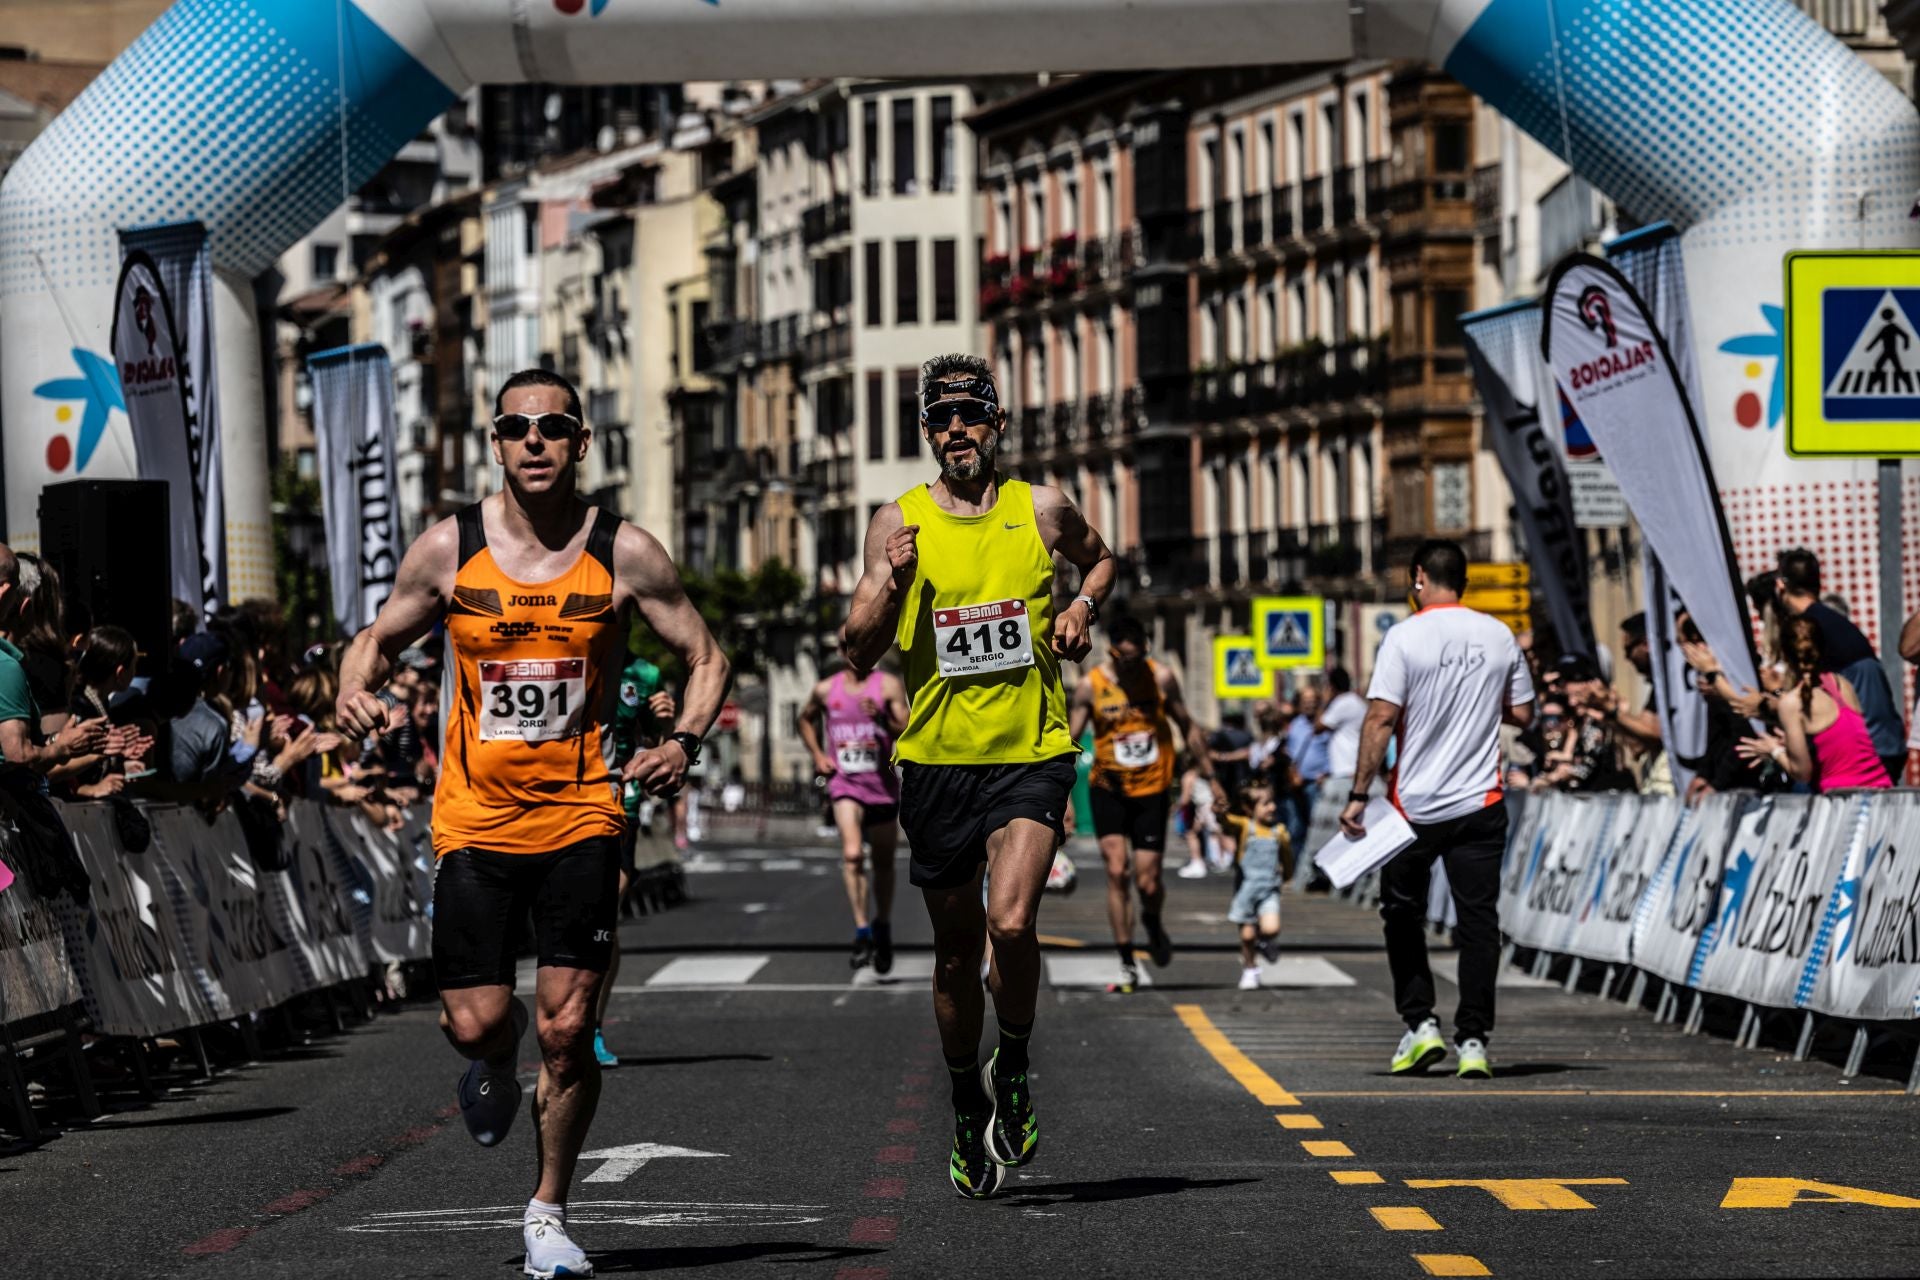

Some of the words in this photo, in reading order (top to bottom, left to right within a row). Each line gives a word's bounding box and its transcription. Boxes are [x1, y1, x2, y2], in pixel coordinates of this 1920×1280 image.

[946, 619, 1022, 657] 418
[969, 652, 1005, 664] SERGIO
[489, 682, 568, 718] 391
[517, 719, 548, 728] JORDI
